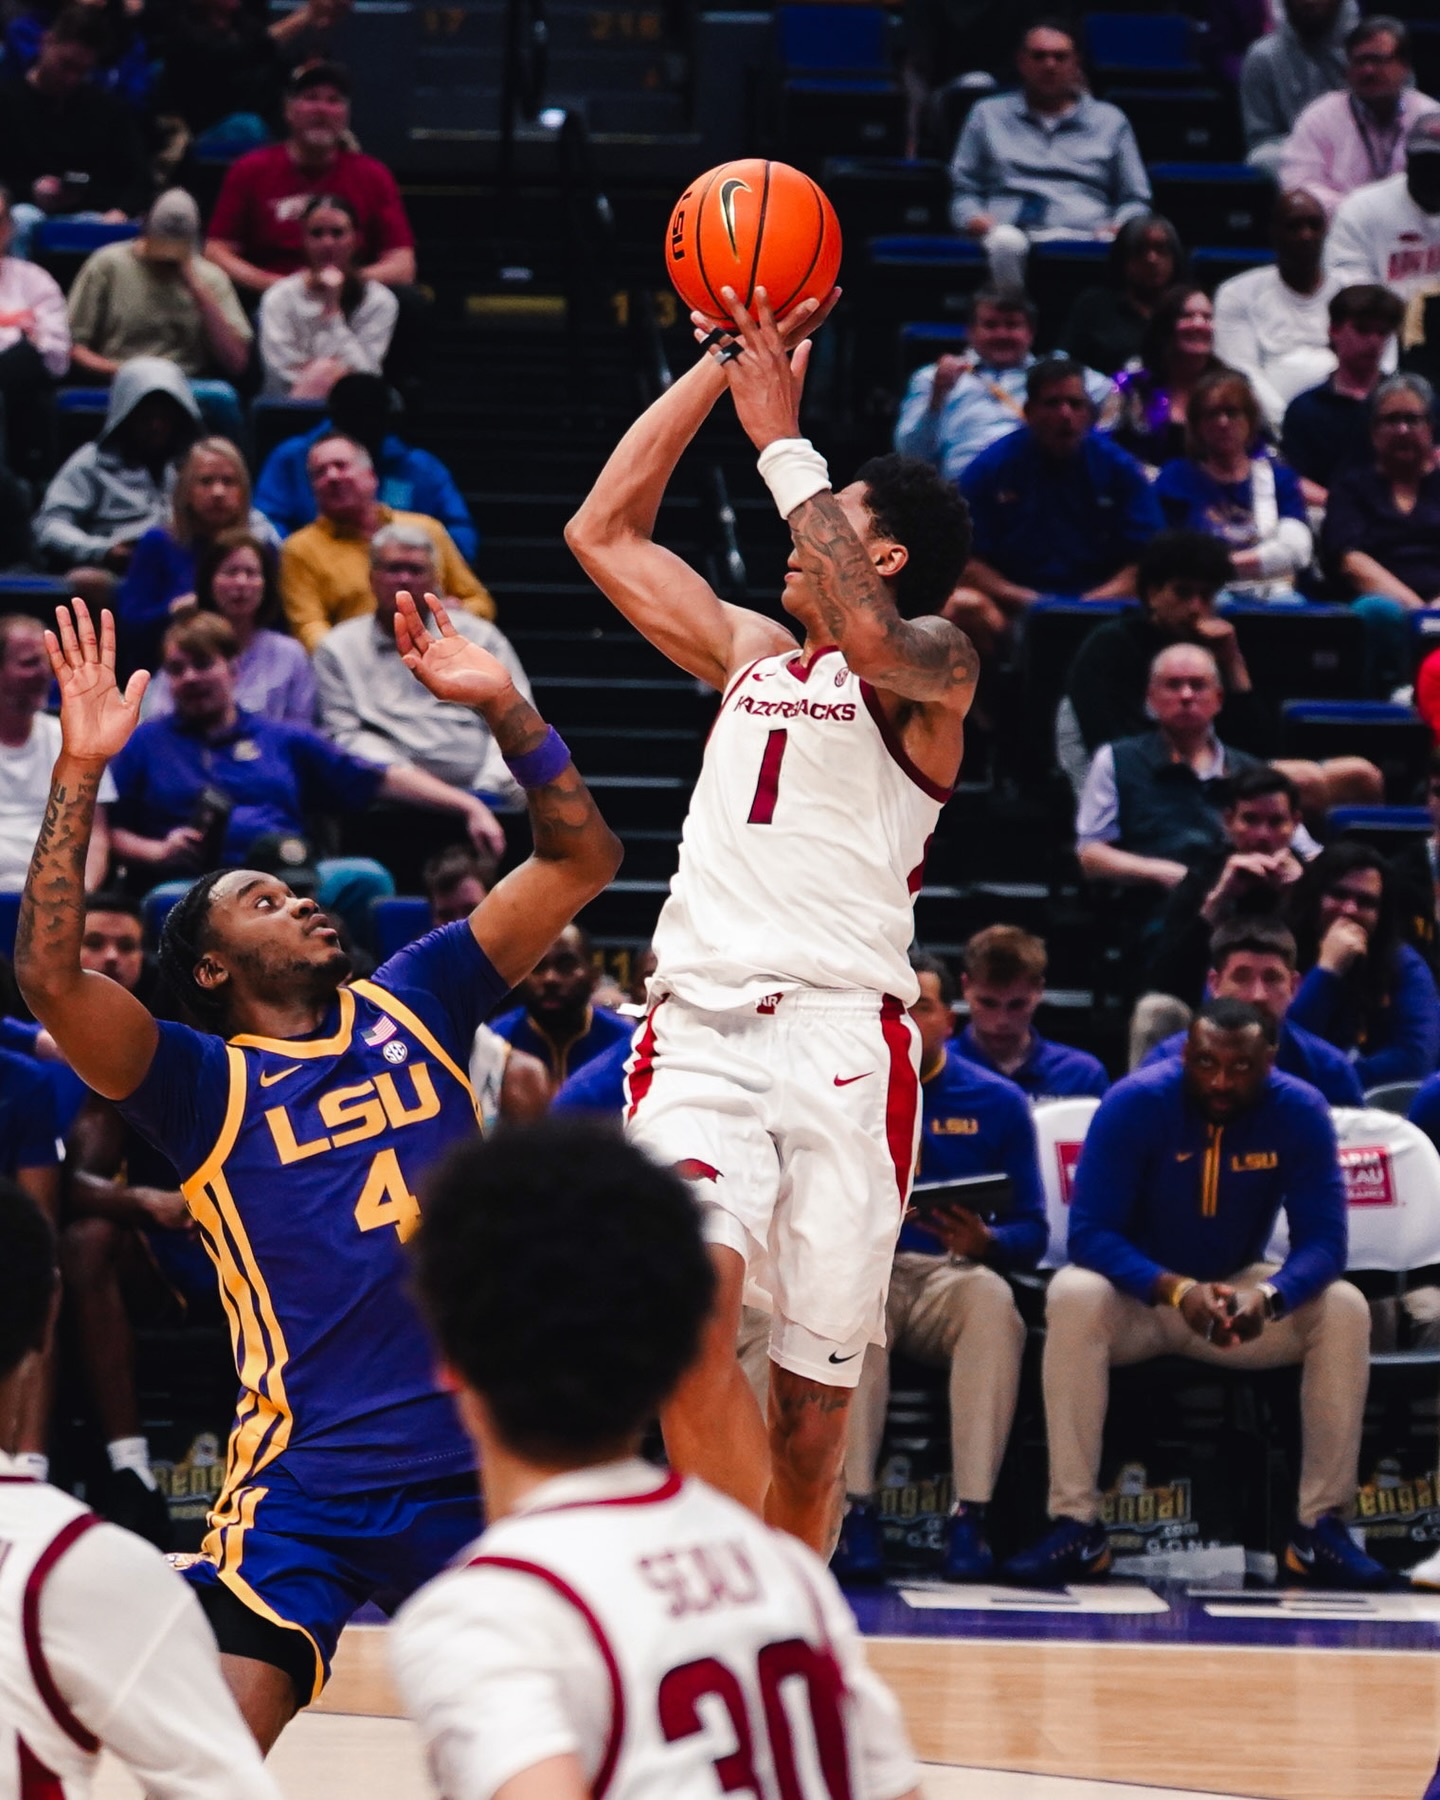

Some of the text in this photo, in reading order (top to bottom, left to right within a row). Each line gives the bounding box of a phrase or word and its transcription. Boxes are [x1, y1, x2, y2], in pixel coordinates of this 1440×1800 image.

[747, 728, 788, 825] 1
[264, 1062, 442, 1166] LSU
[931, 1118, 978, 1135] LSU
[1231, 1152, 1278, 1172] LSU
[354, 1148, 422, 1245] 4
[658, 1638, 853, 1800] 30
